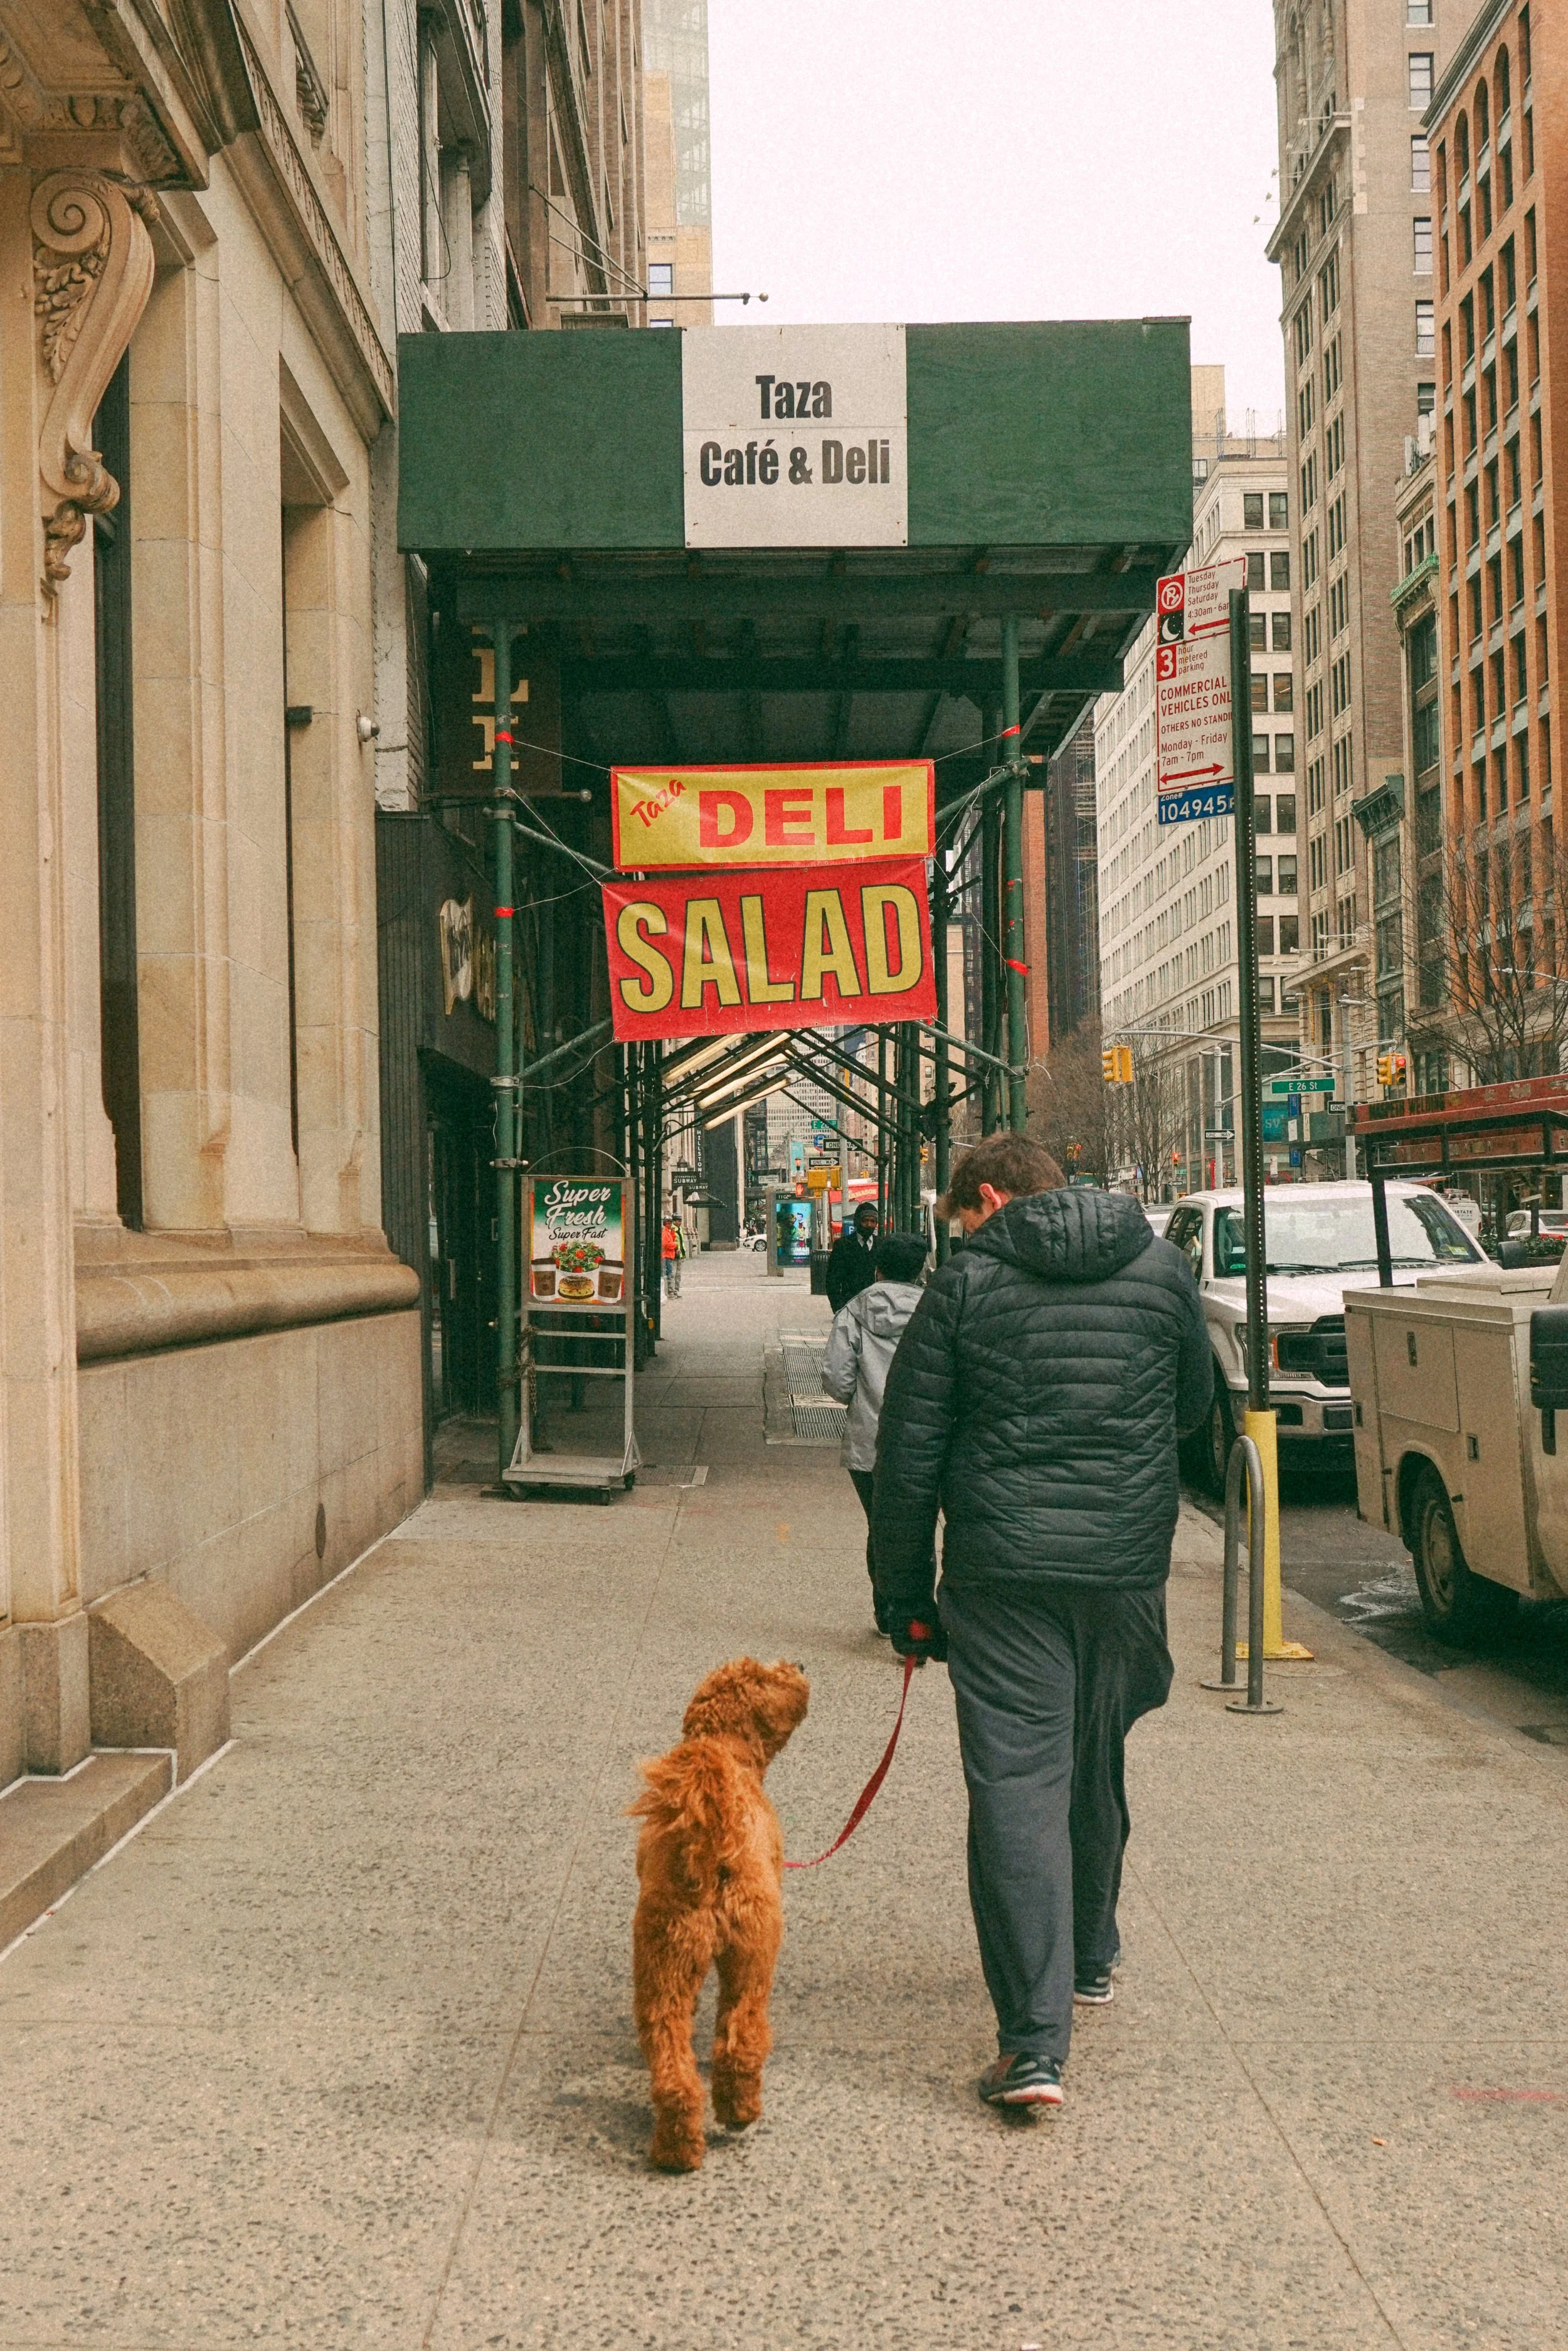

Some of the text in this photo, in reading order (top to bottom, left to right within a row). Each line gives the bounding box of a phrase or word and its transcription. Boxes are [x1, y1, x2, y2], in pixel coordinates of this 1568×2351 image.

[755, 374, 832, 420] Taza
[699, 438, 890, 487] Café & Deli
[1188, 571, 1216, 584] Tuesday
[1188, 581, 1219, 595] Thursday
[1187, 592, 1219, 606] Saturday
[1187, 606, 1212, 619] 4:30am
[1160, 645, 1194, 677] 3 hour
[1179, 650, 1207, 665] metered
[1179, 662, 1204, 676] parking
[1161, 676, 1227, 701] COMMERCIAL
[1161, 691, 1232, 717] VEHICLES ONL
[1161, 721, 1189, 735] OTHERS
[1192, 718, 1202, 728] NO
[1161, 739, 1192, 753] Monday
[1201, 732, 1227, 745] Friday
[1162, 755, 1179, 767] 7am
[1186, 751, 1204, 763] 7pm
[1160, 792, 1184, 802] Zone#
[630, 778, 903, 848] Taza DELI
[1160, 795, 1227, 822] 104945
[616, 883, 924, 1014] SALAD
[1289, 1081, 1318, 1091] E 26 St
[544, 1180, 611, 1206] Super
[546, 1202, 607, 1228] Fresh
[549, 1226, 608, 1240] Super Fast
